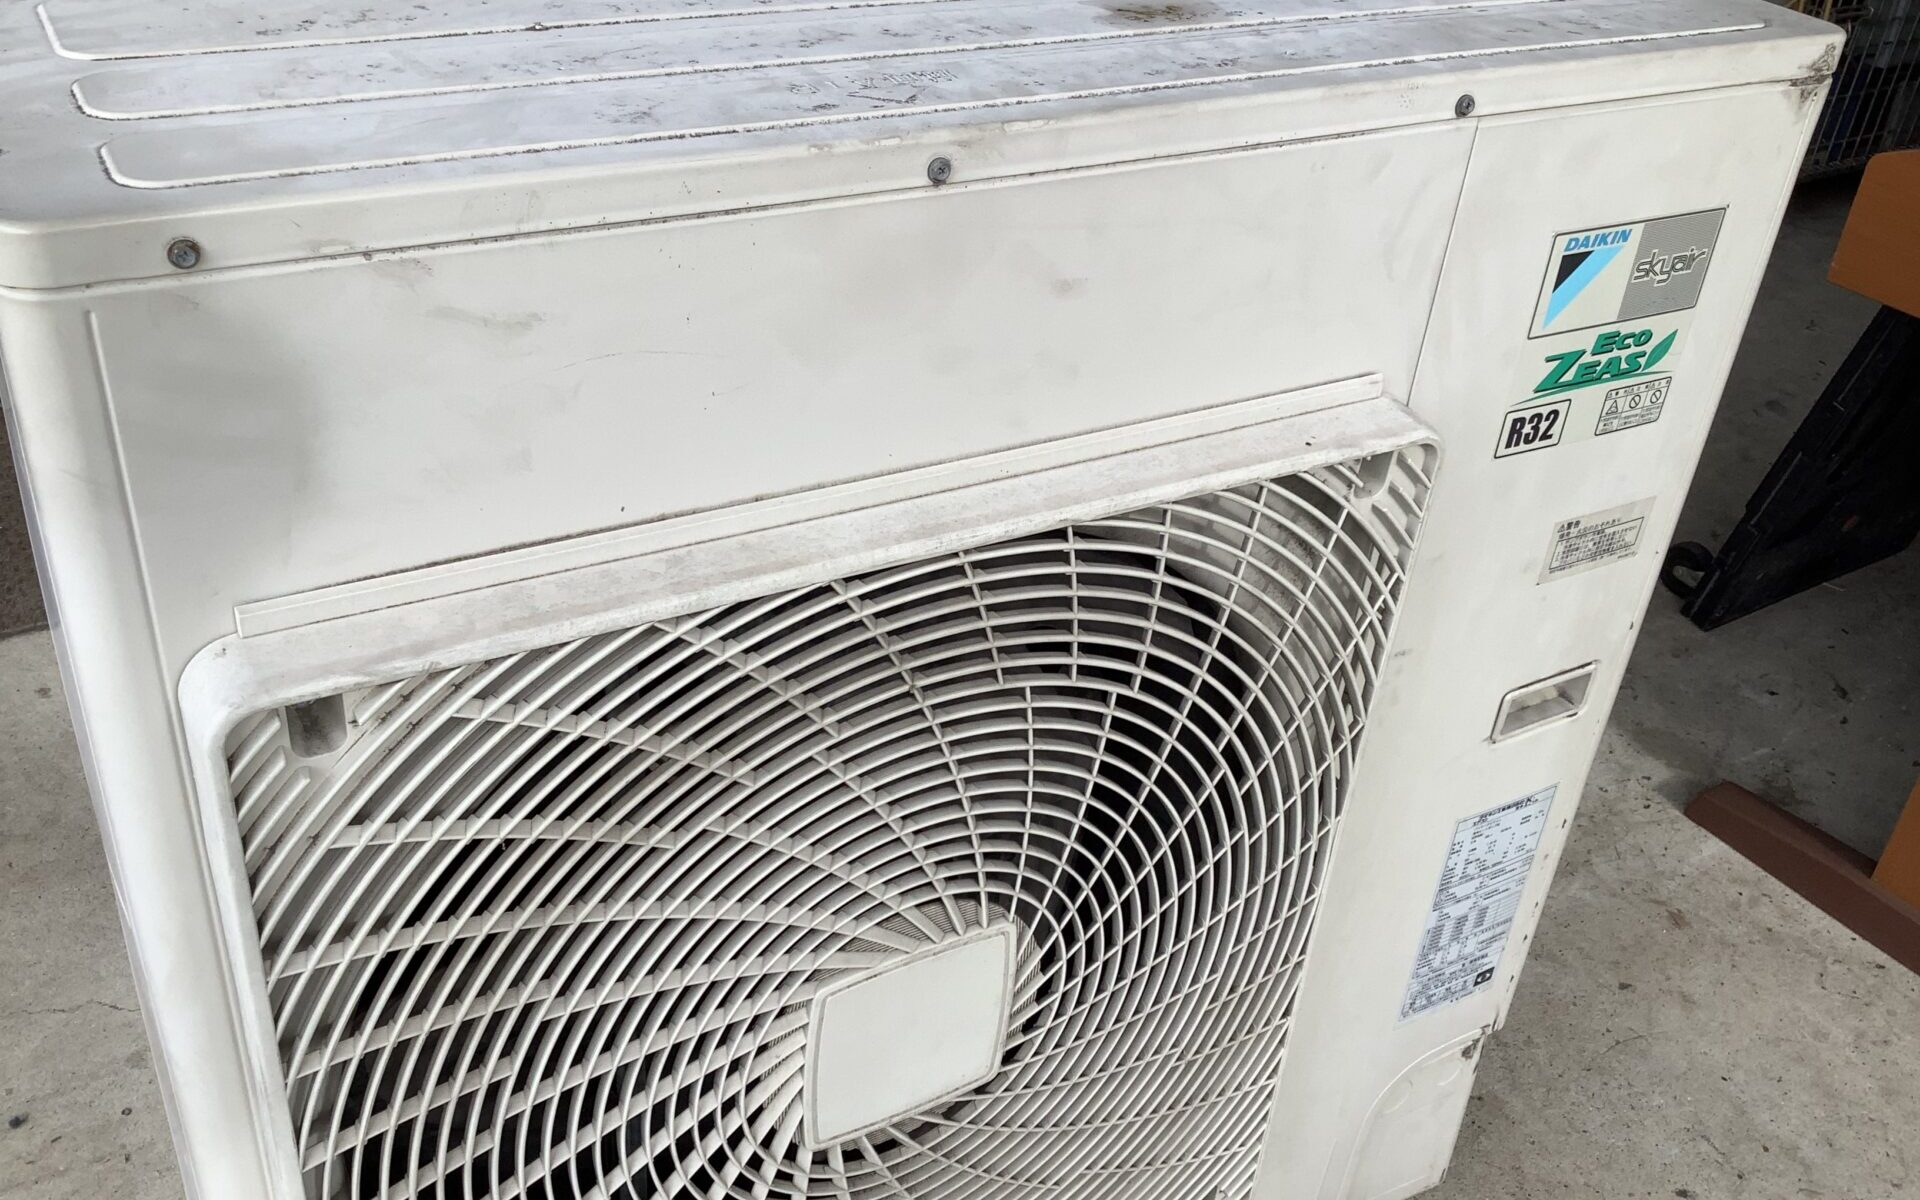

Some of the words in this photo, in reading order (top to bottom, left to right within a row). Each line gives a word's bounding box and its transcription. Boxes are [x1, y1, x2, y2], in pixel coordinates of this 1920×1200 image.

[1563, 228, 1632, 252] DAIKIN
[1534, 350, 1647, 393] ZEAS
[1505, 409, 1560, 450] R32
